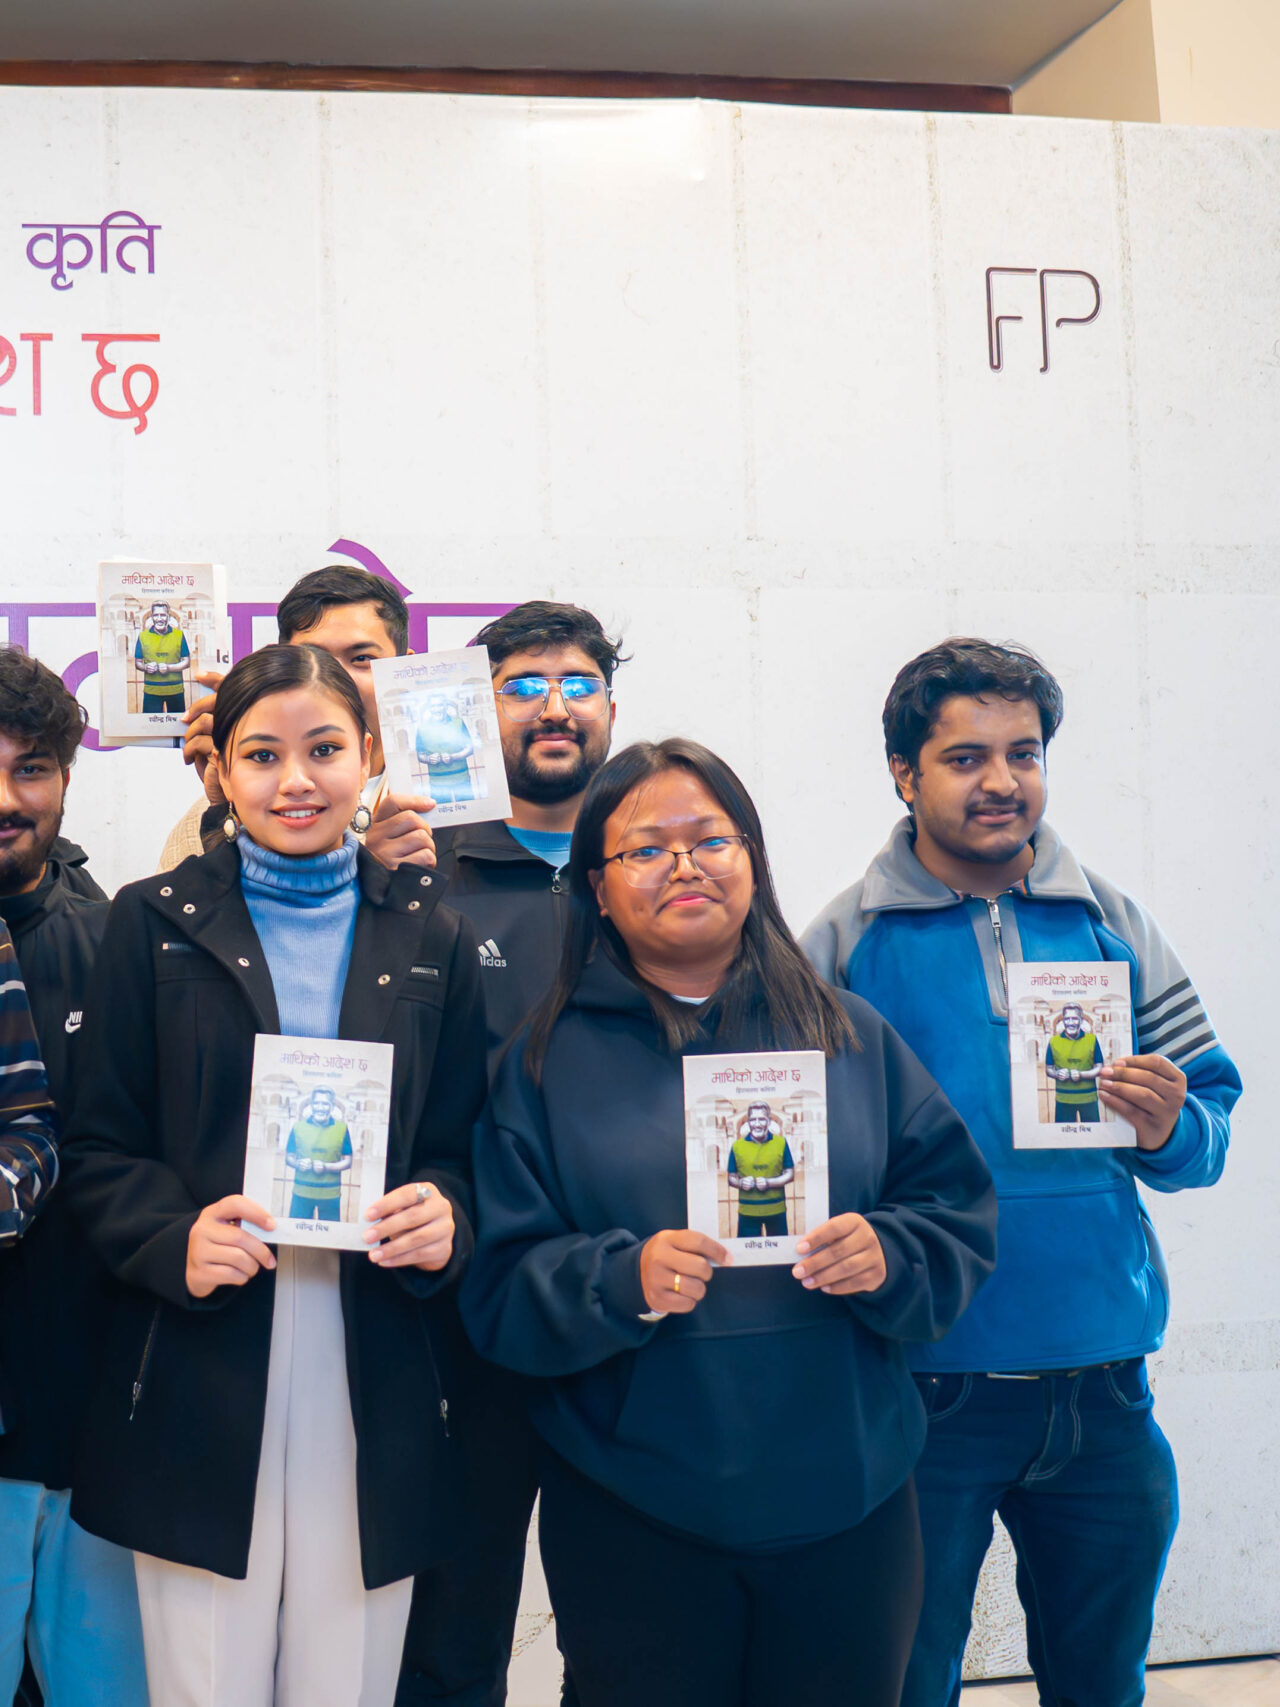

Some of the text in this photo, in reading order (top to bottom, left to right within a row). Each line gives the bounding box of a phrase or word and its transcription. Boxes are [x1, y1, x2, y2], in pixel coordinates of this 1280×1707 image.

[22, 210, 162, 291] कृति
[985, 266, 1101, 373] FP
[81, 333, 161, 436] छ
